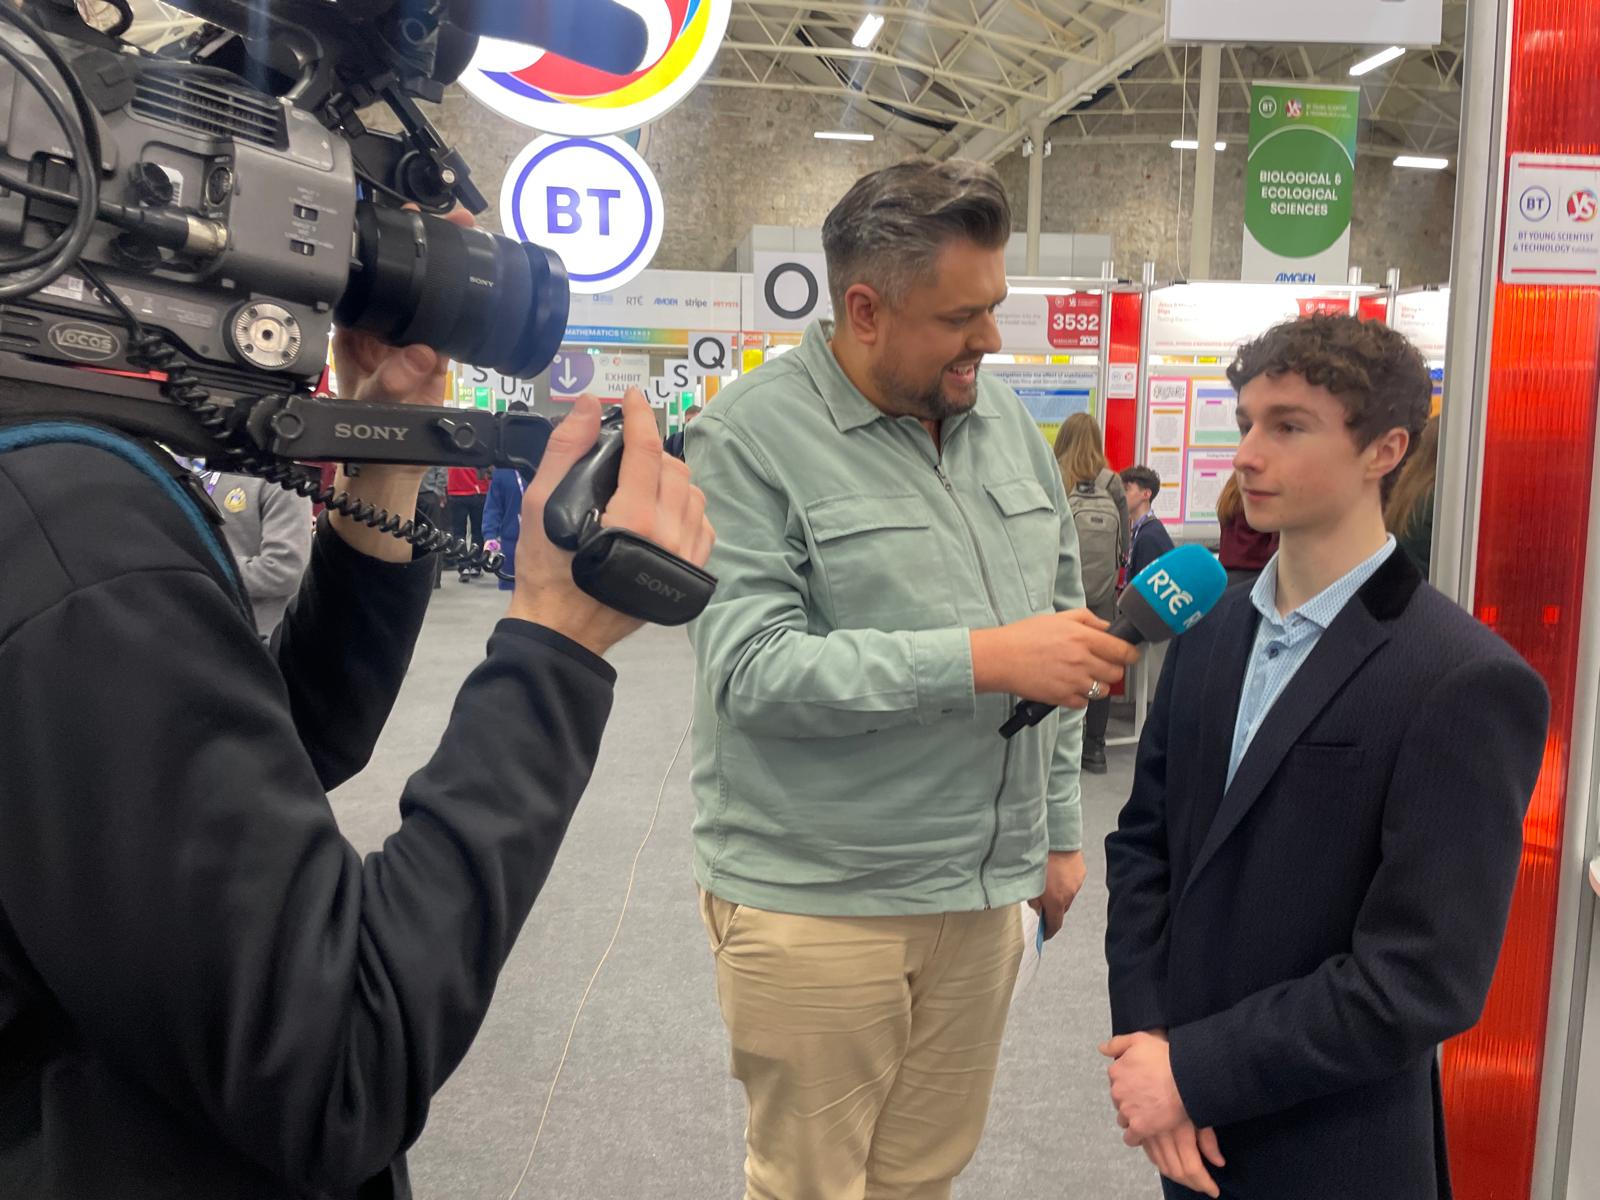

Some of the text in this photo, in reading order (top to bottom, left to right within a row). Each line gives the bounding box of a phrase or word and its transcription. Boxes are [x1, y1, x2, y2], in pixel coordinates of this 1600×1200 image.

[1259, 170, 1342, 186] BIOLOGICAL &
[1261, 186, 1338, 201] ECOLOGICAL
[546, 186, 621, 236] BT
[1270, 202, 1328, 216] SCIENCES
[1526, 197, 1544, 211] BT
[1518, 231, 1593, 242] BT YOUNG SCIENTIST
[1512, 243, 1518, 252] &
[1520, 243, 1570, 253] TECHNOLOGY
[1275, 272, 1316, 283] AMGEN
[764, 262, 819, 320] O
[684, 298, 708, 308] stripe
[1053, 313, 1099, 331] 3532
[565, 328, 620, 338] MATHEMATICS
[694, 337, 726, 370] Q
[605, 372, 641, 382] EXHIBIT
[673, 364, 689, 388] S
[501, 376, 517, 395] U
[334, 423, 409, 441] SONY
[634, 572, 687, 603] SONY
